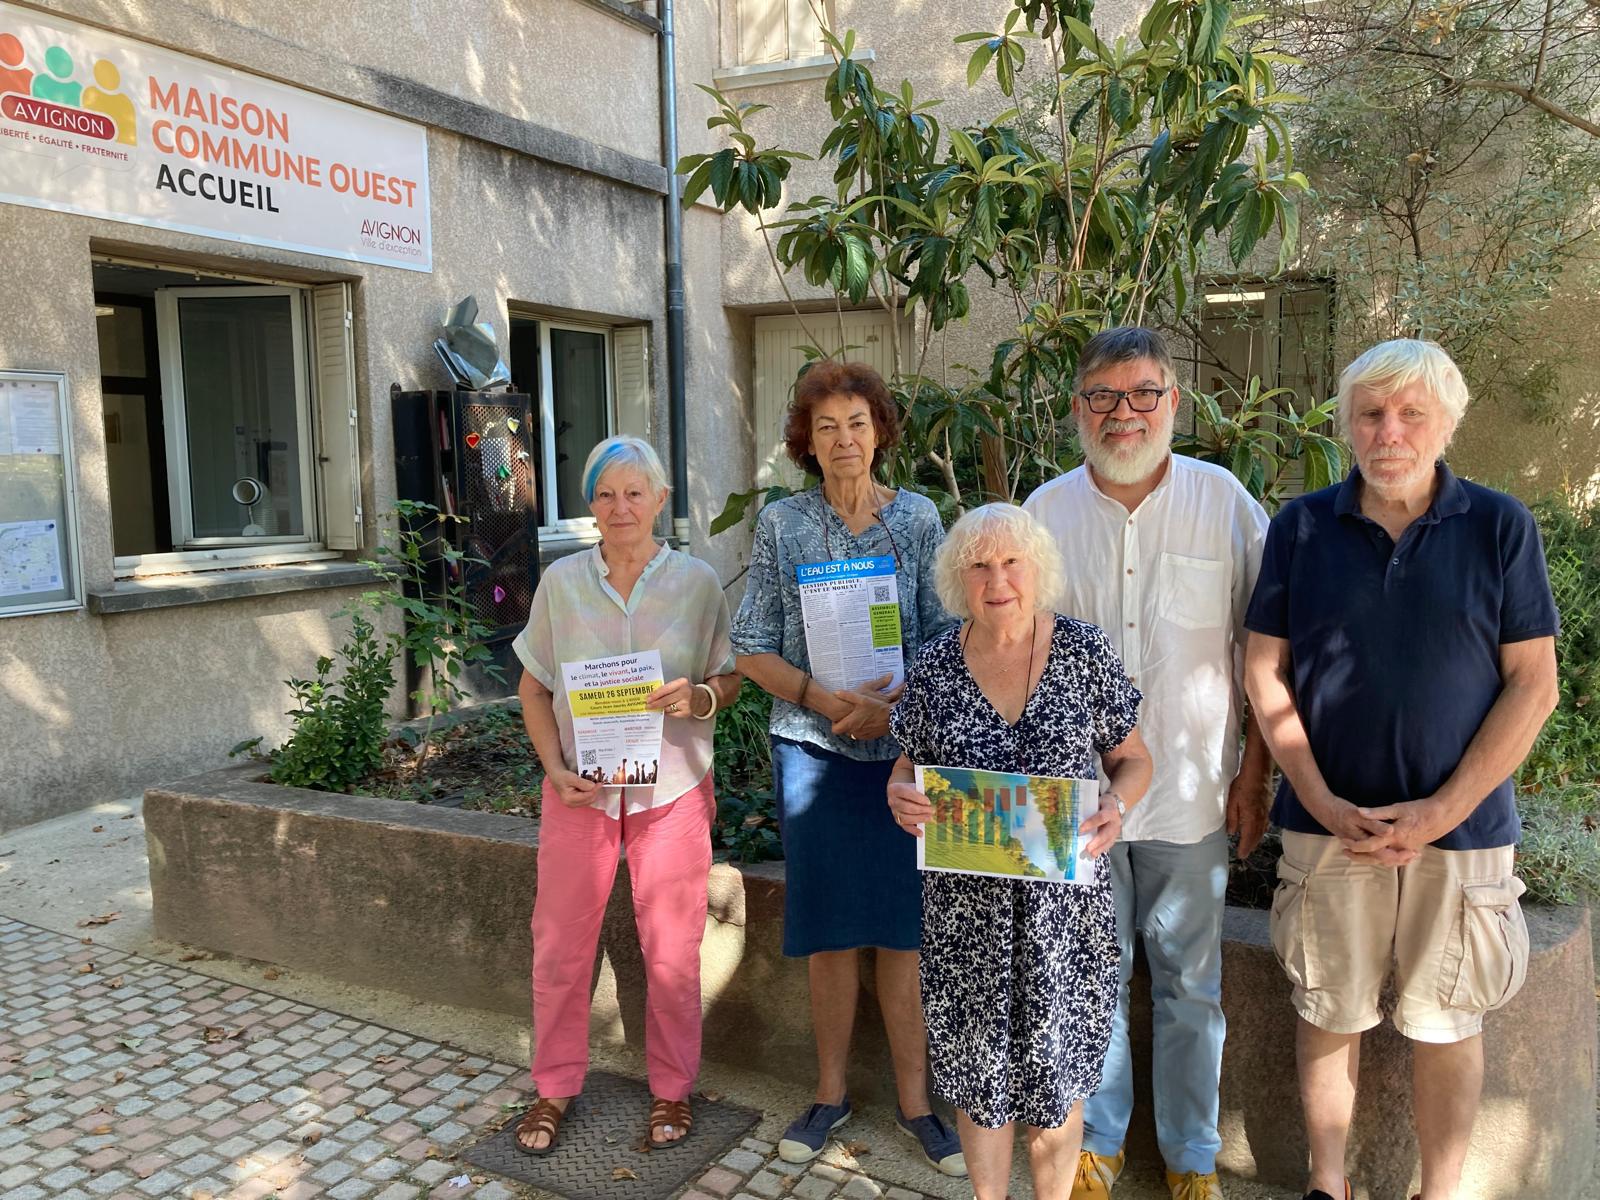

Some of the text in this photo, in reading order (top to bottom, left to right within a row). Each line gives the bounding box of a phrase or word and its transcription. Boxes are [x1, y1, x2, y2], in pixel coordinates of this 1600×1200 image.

[14, 102, 104, 136] AVIGNON
[148, 75, 289, 144] MAISON
[0, 127, 129, 161] IBERTÉ ÉGALITÉ FRATERNITÉ
[152, 118, 417, 209] COMMUNE OUEST
[155, 163, 280, 214] ACCUEIL
[361, 219, 421, 245] AVIGNON
[361, 237, 376, 248] Ville
[801, 567, 824, 577] L'EAU
[826, 564, 841, 574] EST
[851, 560, 875, 571] NOUS
[584, 657, 638, 671] Marchons pour
[579, 685, 654, 701] SAMEDI 26 SEPTEMBRE
[599, 678, 621, 688] justice
[621, 675, 644, 684] sociale
